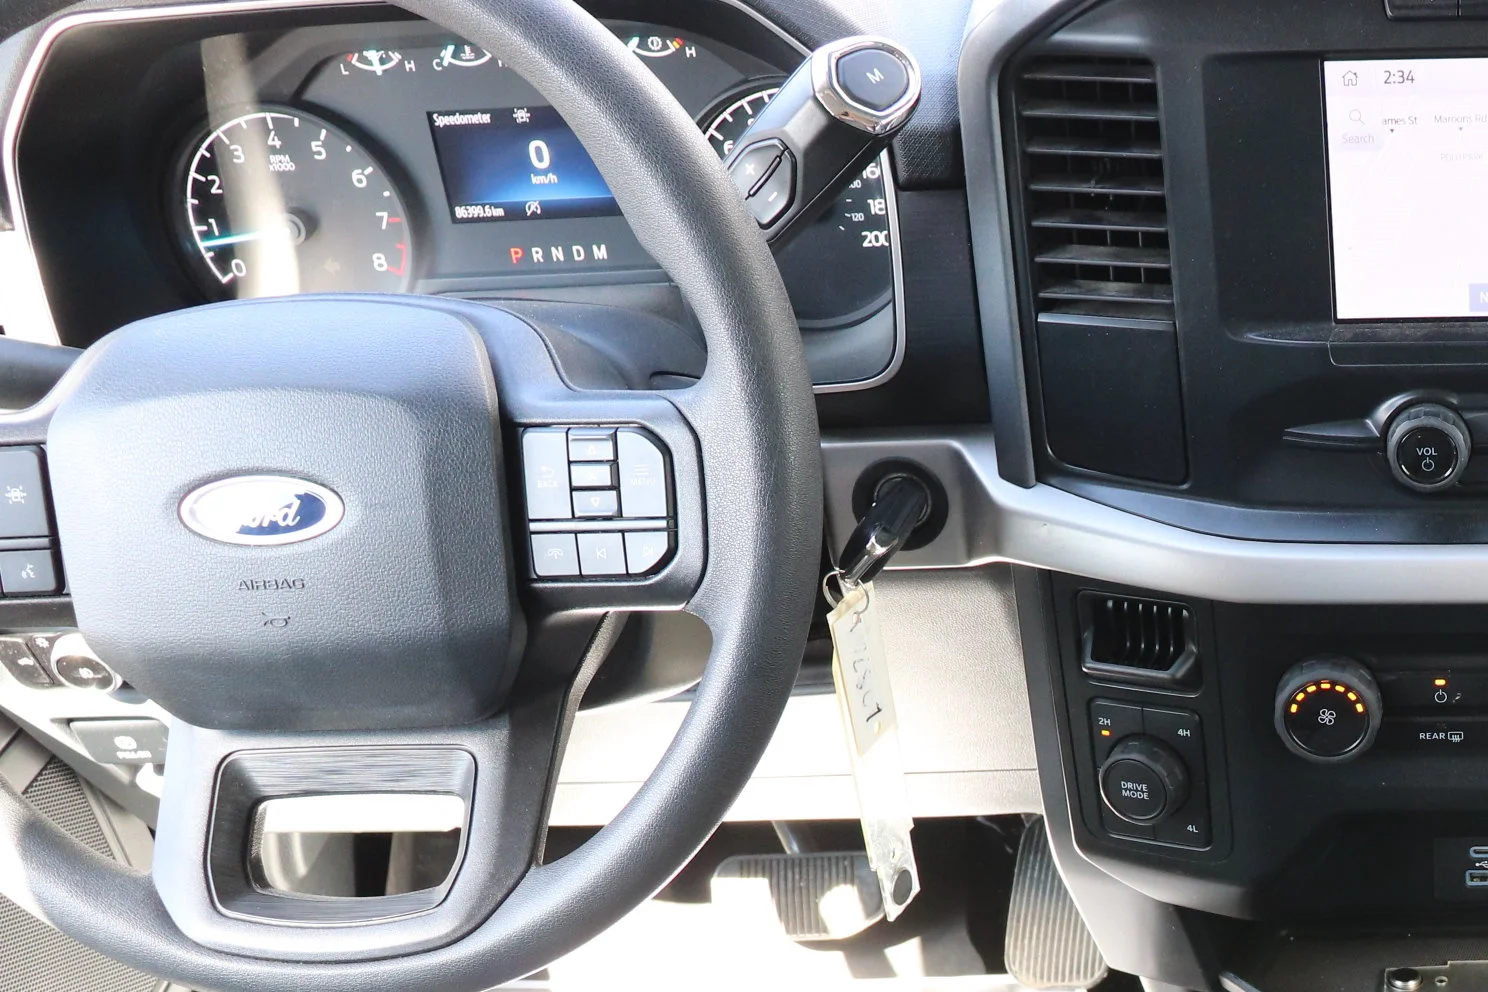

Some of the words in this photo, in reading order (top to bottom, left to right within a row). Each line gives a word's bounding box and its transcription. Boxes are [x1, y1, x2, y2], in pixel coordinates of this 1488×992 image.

[685, 46, 697, 58] H
[340, 63, 349, 75] L
[404, 60, 416, 72] H
[432, 59, 443, 71] C
[866, 68, 884, 84] M
[1382, 69, 1416, 85] 2:34
[432, 112, 492, 128] Speedometer
[267, 130, 282, 149] 4
[1342, 134, 1375, 145] Search
[229, 144, 245, 163] 3
[311, 141, 327, 160] 5
[528, 139, 551, 170] 0
[269, 154, 291, 164] RPM
[268, 162, 295, 172] x1000
[207, 175, 223, 194] 2
[351, 169, 367, 188] 6
[530, 173, 558, 185] km/h
[454, 204, 491, 219] 86399.6
[492, 205, 505, 218] km
[851, 212, 865, 221] 120
[375, 211, 389, 230] 7
[208, 218, 219, 236] 1
[510, 247, 524, 264] P
[531, 247, 544, 263] R
[551, 246, 564, 262] N
[572, 245, 585, 261] D
[592, 244, 608, 260] M
[231, 258, 247, 277] 0
[372, 252, 388, 272] 8
[1480, 291, 1488, 303] N
[1416, 446, 1438, 456] VOL
[238, 578, 305, 591] AIRBAG
[1098, 717, 1111, 726] 2H
[1177, 728, 1191, 737] 4H
[1419, 731, 1446, 740] REAR
[1120, 780, 1149, 792] DRIVE
[1121, 789, 1150, 800] MODE
[1186, 823, 1199, 833] 4L
